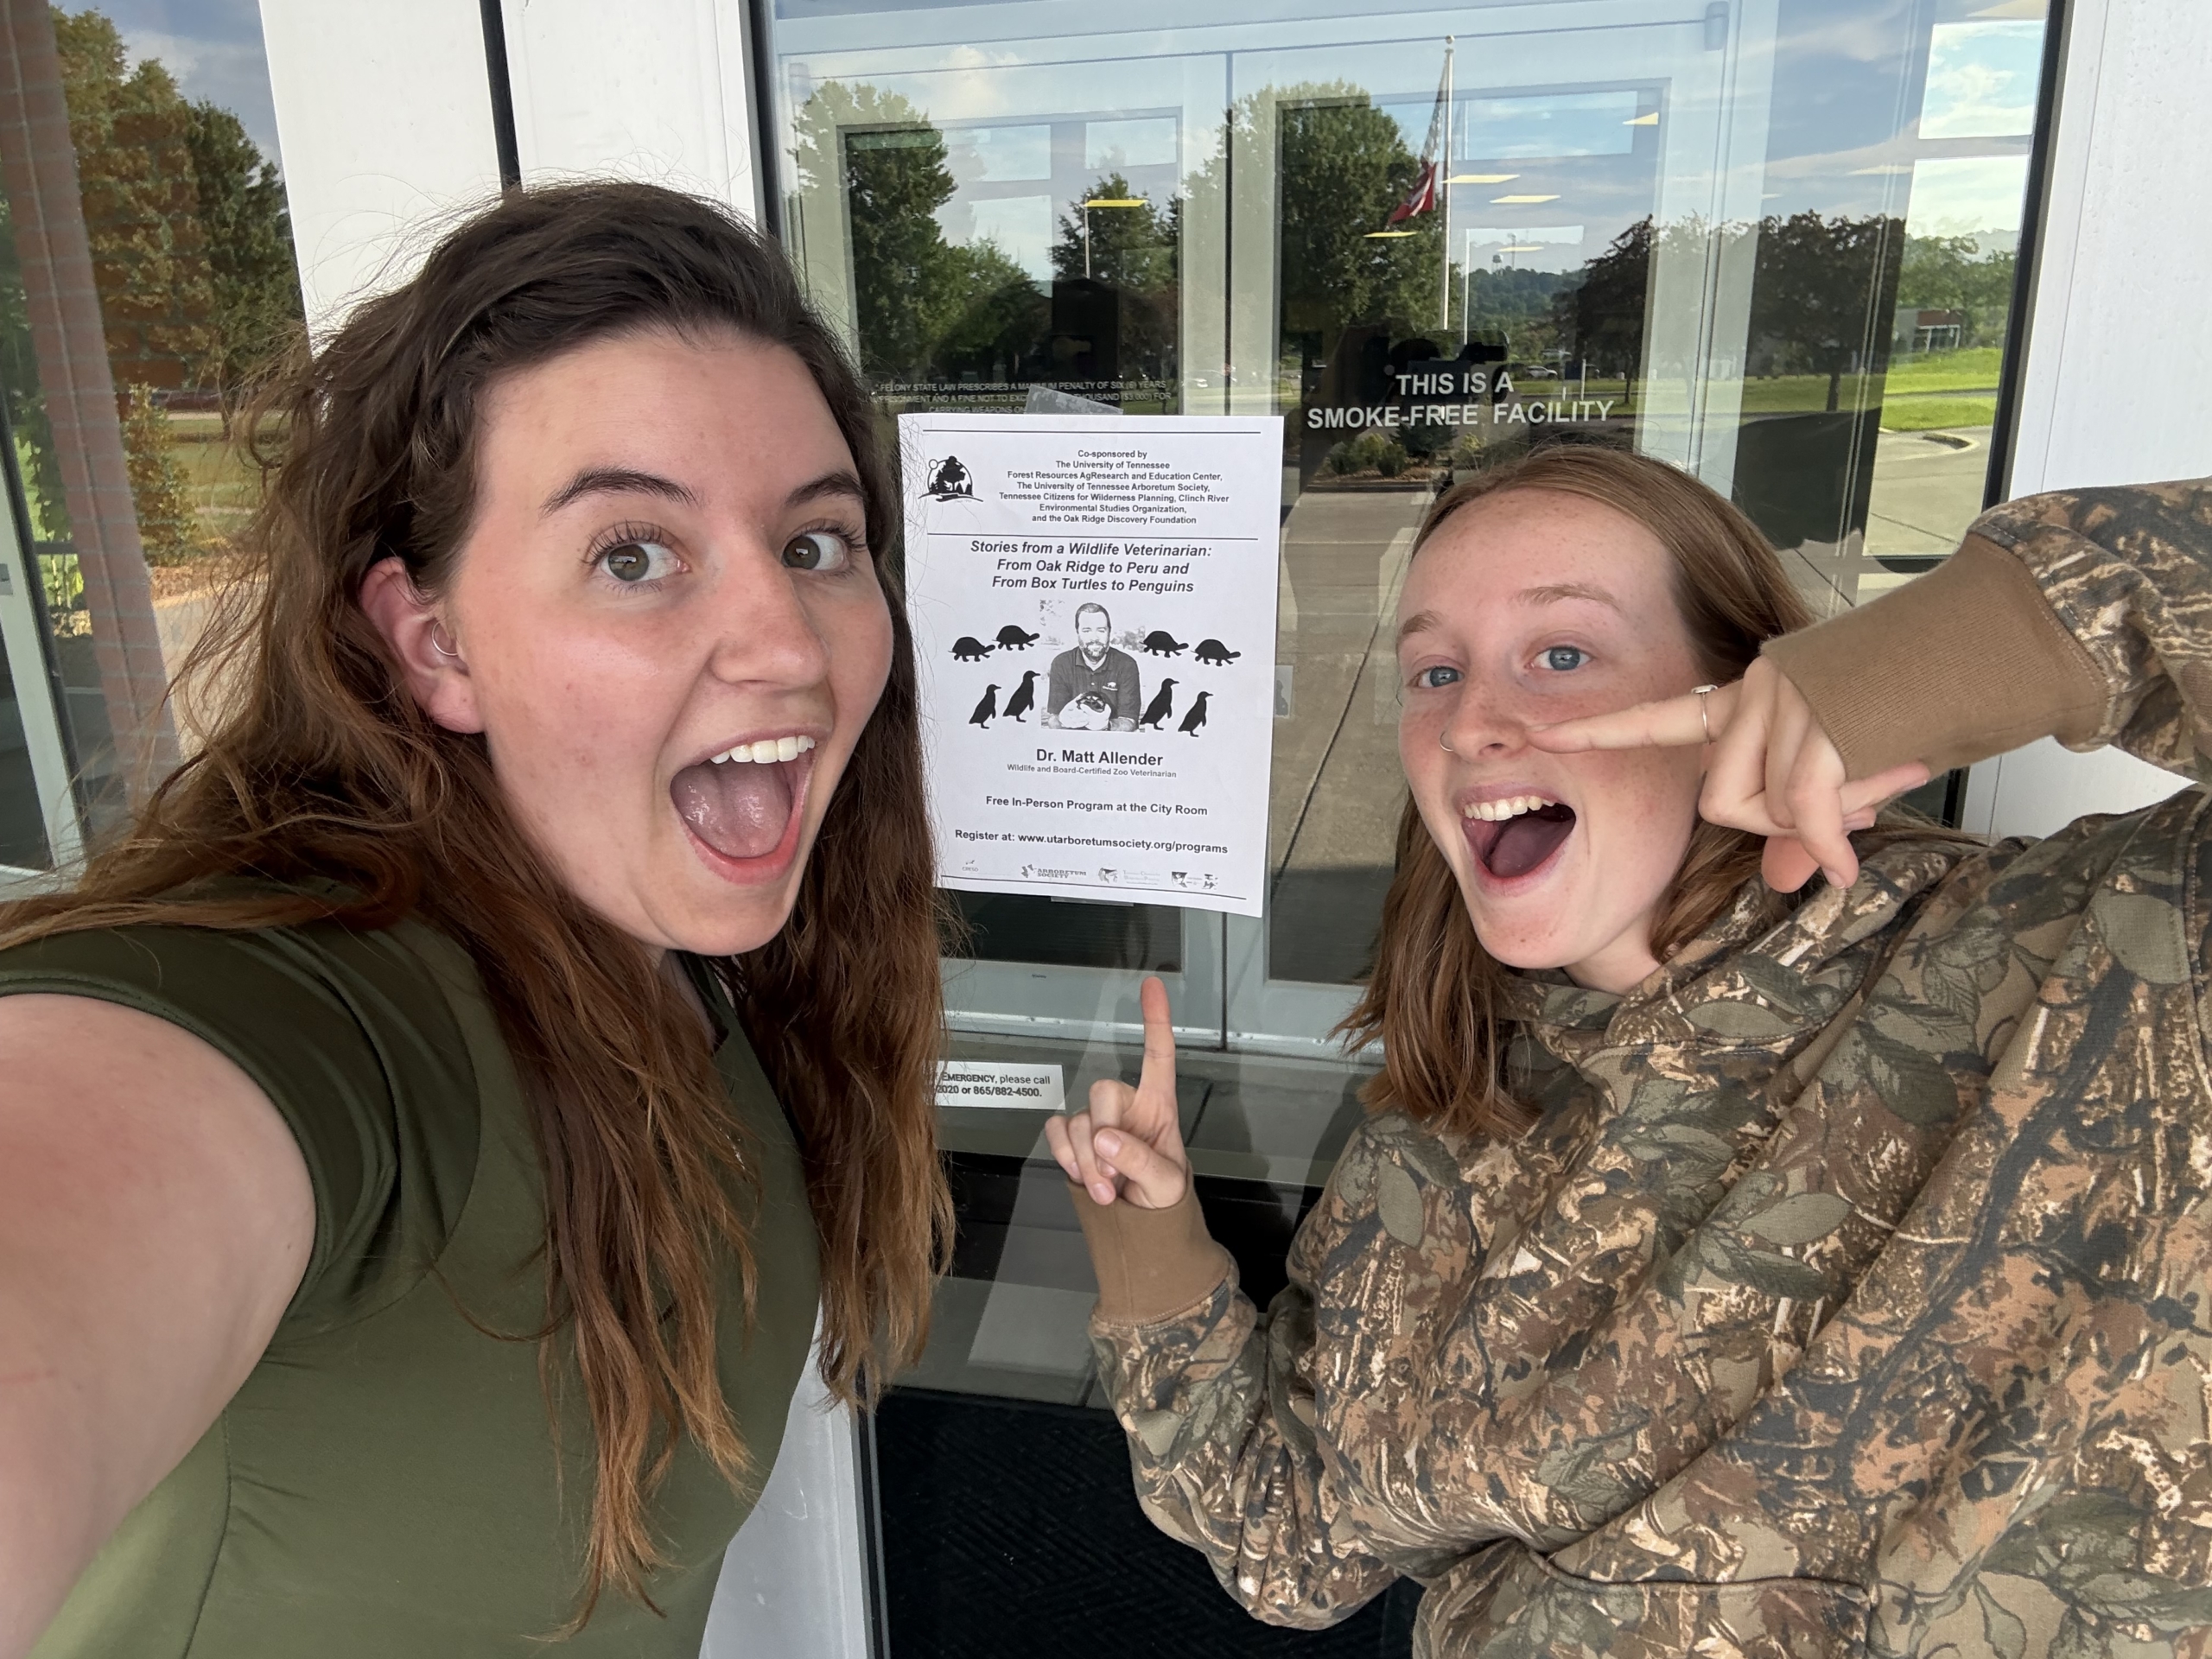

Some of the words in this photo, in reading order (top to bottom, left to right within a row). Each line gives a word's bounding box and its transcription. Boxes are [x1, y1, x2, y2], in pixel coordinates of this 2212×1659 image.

[938, 383, 956, 391] LAW
[1096, 381, 1109, 390] OF
[1138, 380, 1166, 389] YEARS
[1395, 373, 1454, 396] THIS
[1463, 372, 1487, 394] IS
[1494, 372, 1515, 393] A
[1307, 404, 1478, 429] SMOKE-FREE
[1493, 400, 1615, 424] FACILITY
[1077, 449, 1135, 459] Co-sponsored
[1137, 449, 1147, 460] by
[1072, 460, 1114, 470] University
[1007, 470, 1033, 479] Forest
[1035, 470, 1077, 479] Resources
[1079, 471, 1128, 480] AgResearch
[1192, 472, 1222, 481] Center,
[1033, 481, 1074, 492] University
[1131, 482, 1175, 491] Arboretum
[1177, 483, 1210, 493] Society,
[1138, 493, 1176, 503] Planning,
[1039, 503, 1097, 512] Environmental
[1132, 505, 1186, 514] Organization,
[1081, 514, 1105, 524] Ridge
[1107, 514, 1147, 524] Discovery
[1149, 515, 1196, 524] Foundation
[970, 540, 1018, 552] Stories
[1021, 541, 1052, 554] from
[1056, 544, 1064, 554] a
[1069, 542, 1119, 555] Wildlife
[1124, 543, 1211, 556] Veterinarian:
[996, 558, 1032, 570] From
[1036, 559, 1062, 571] Oak
[1065, 560, 1104, 575] Ridge
[1109, 562, 1122, 573] to
[1126, 562, 1158, 574] Peru
[1162, 562, 1189, 574] and
[992, 575, 1027, 588] From
[1031, 576, 1057, 588] Box
[1061, 577, 1107, 590] Turtles
[1111, 579, 1124, 590] to
[1128, 579, 1193, 594] Penguins
[1036, 748, 1056, 761] Dr.
[1062, 749, 1094, 763] Matt
[1098, 751, 1163, 766] Allender
[1007, 763, 1035, 772] Wildlife
[1052, 766, 1111, 774] Board-Certified
[1129, 769, 1176, 778] Veterinarian
[986, 795, 1008, 805] Free
[1012, 797, 1063, 808] In-Person
[1066, 799, 1113, 811] Program
[1116, 803, 1127, 811] at
[1129, 803, 1147, 812] the
[1150, 803, 1172, 815] City
[1175, 804, 1207, 815] Room
[955, 829, 999, 841] Register
[1001, 832, 1014, 841] at:
[1017, 835, 1228, 853] www.utarboretumsociety.org/programs
[942, 1072, 997, 1084] EMERGENCY,
[1000, 1075, 1031, 1084] please
[1033, 1075, 1051, 1084] call
[974, 1085, 1042, 1097] 865/882-4500.
